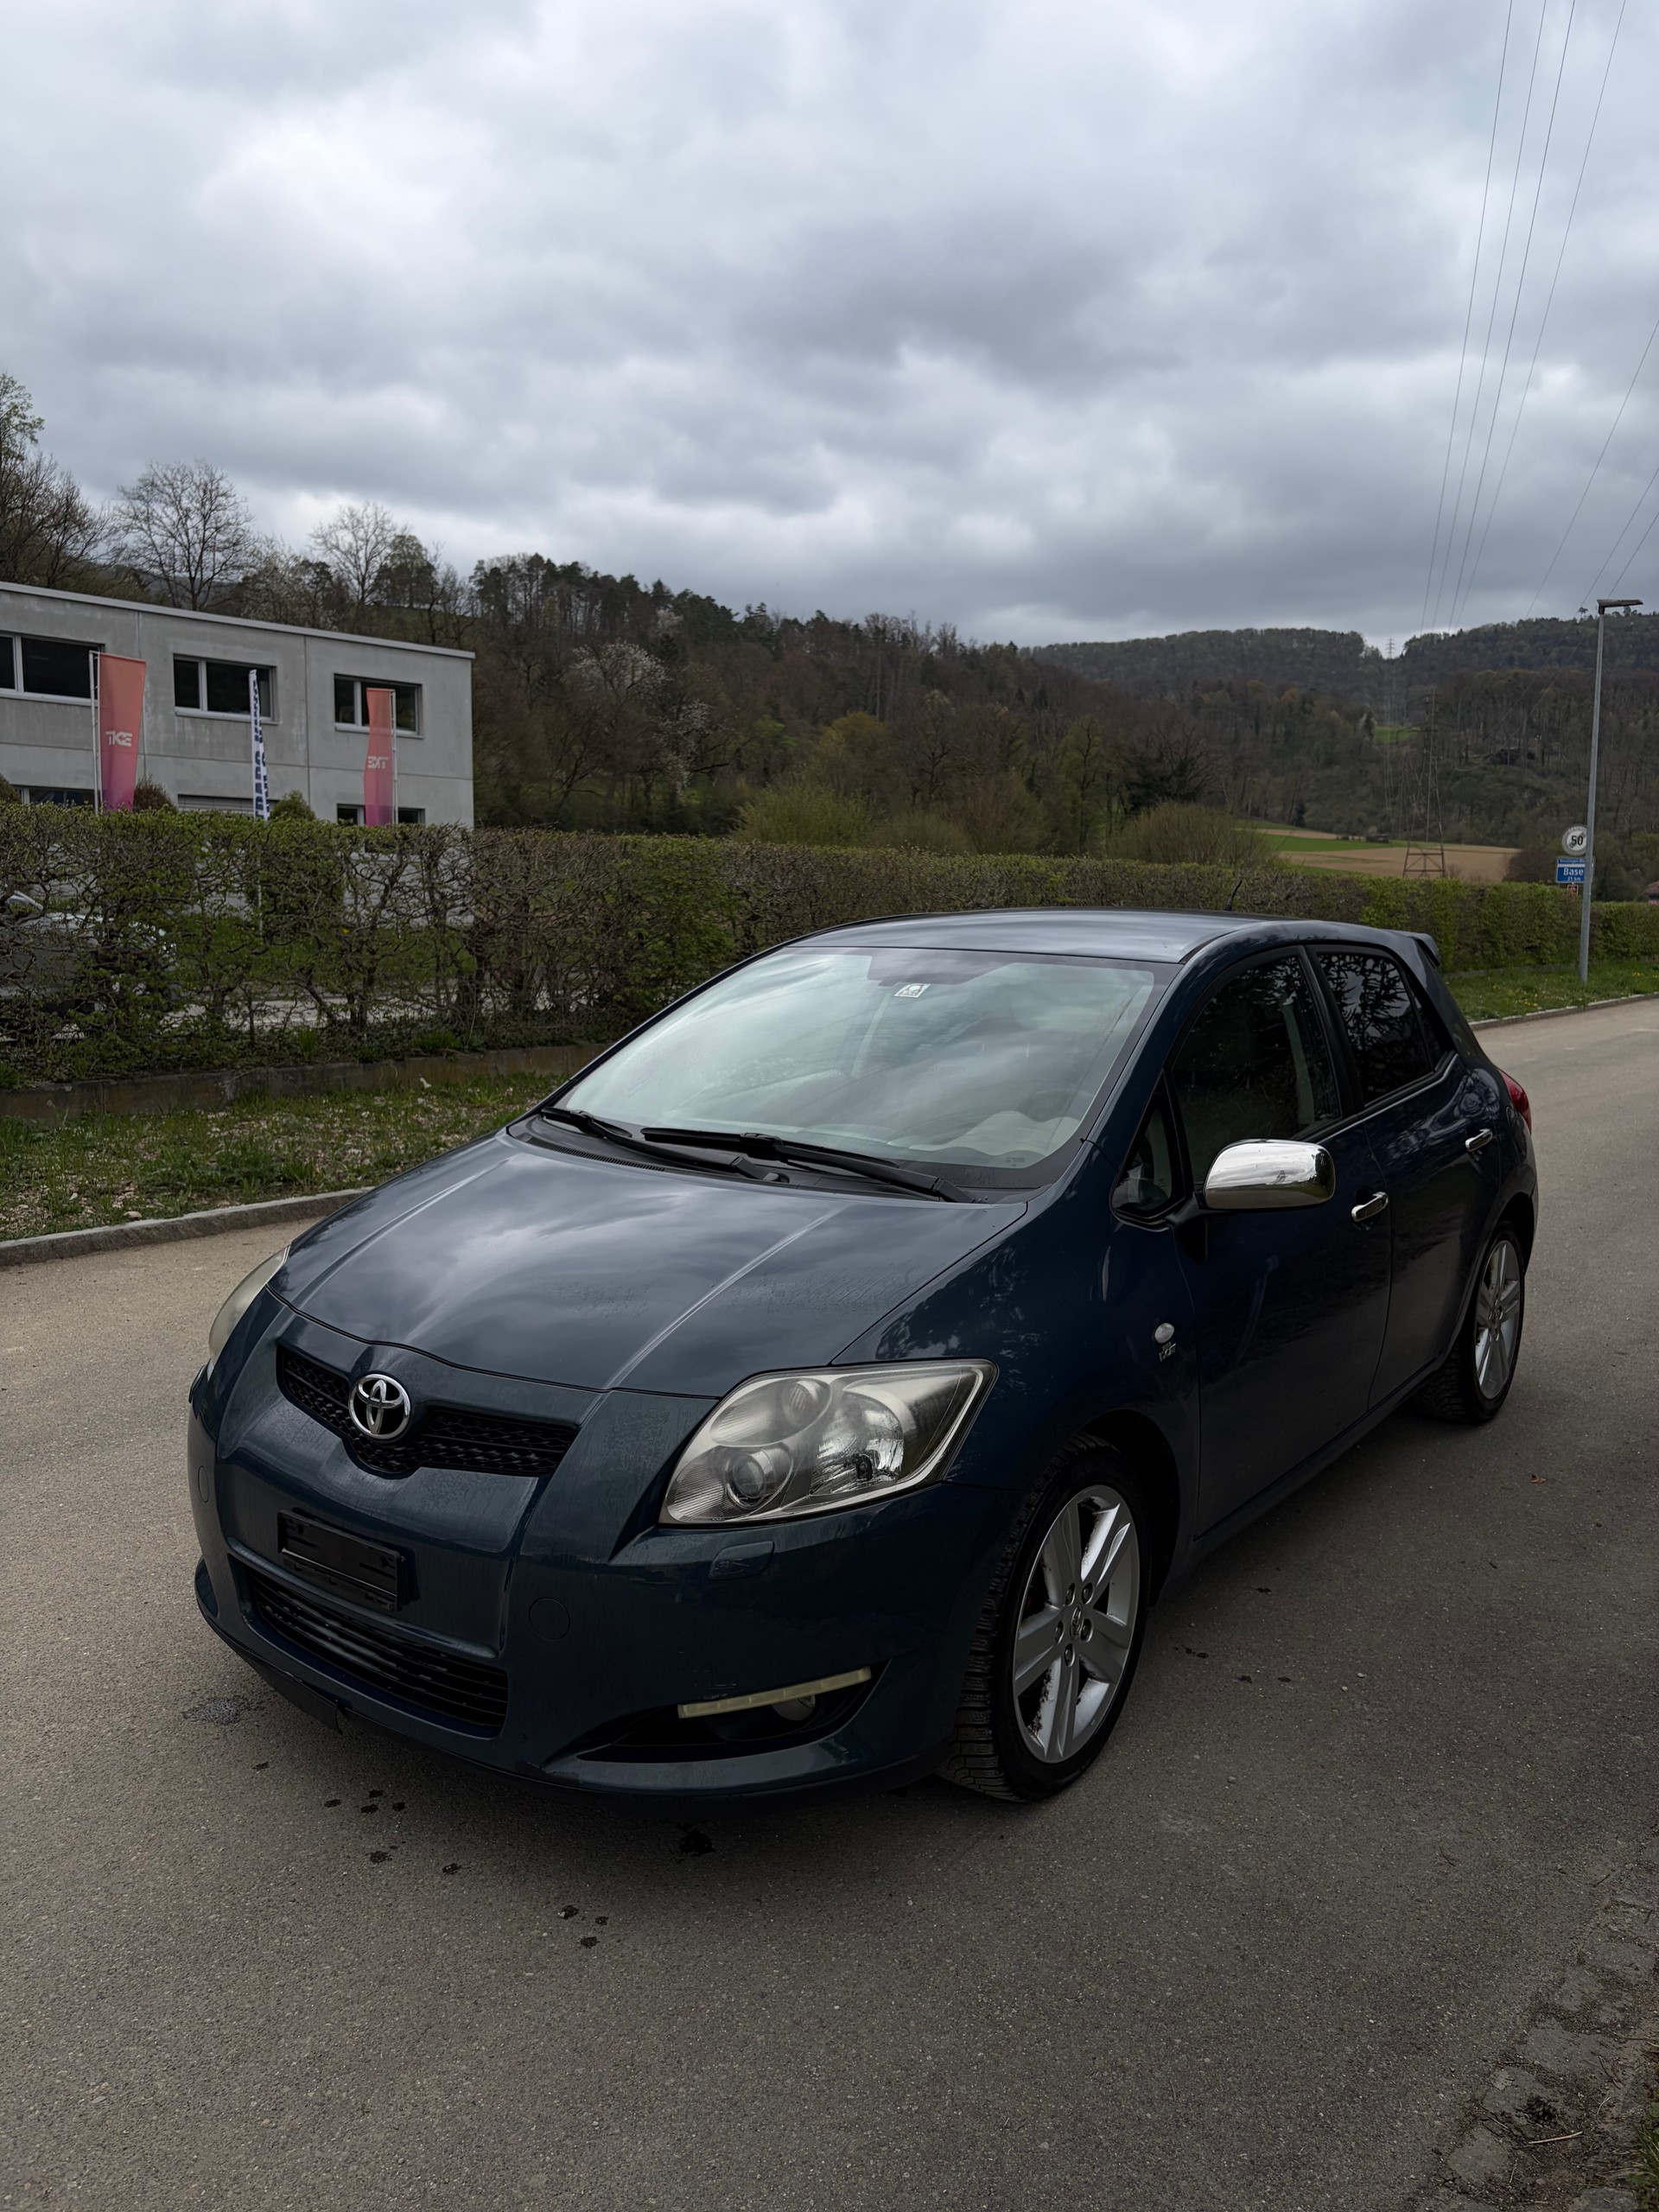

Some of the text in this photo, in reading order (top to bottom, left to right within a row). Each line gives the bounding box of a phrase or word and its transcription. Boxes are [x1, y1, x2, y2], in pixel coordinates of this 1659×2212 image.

[105, 730, 133, 747] TKE
[1571, 835, 1584, 846] 50
[1563, 868, 1584, 876] Base
